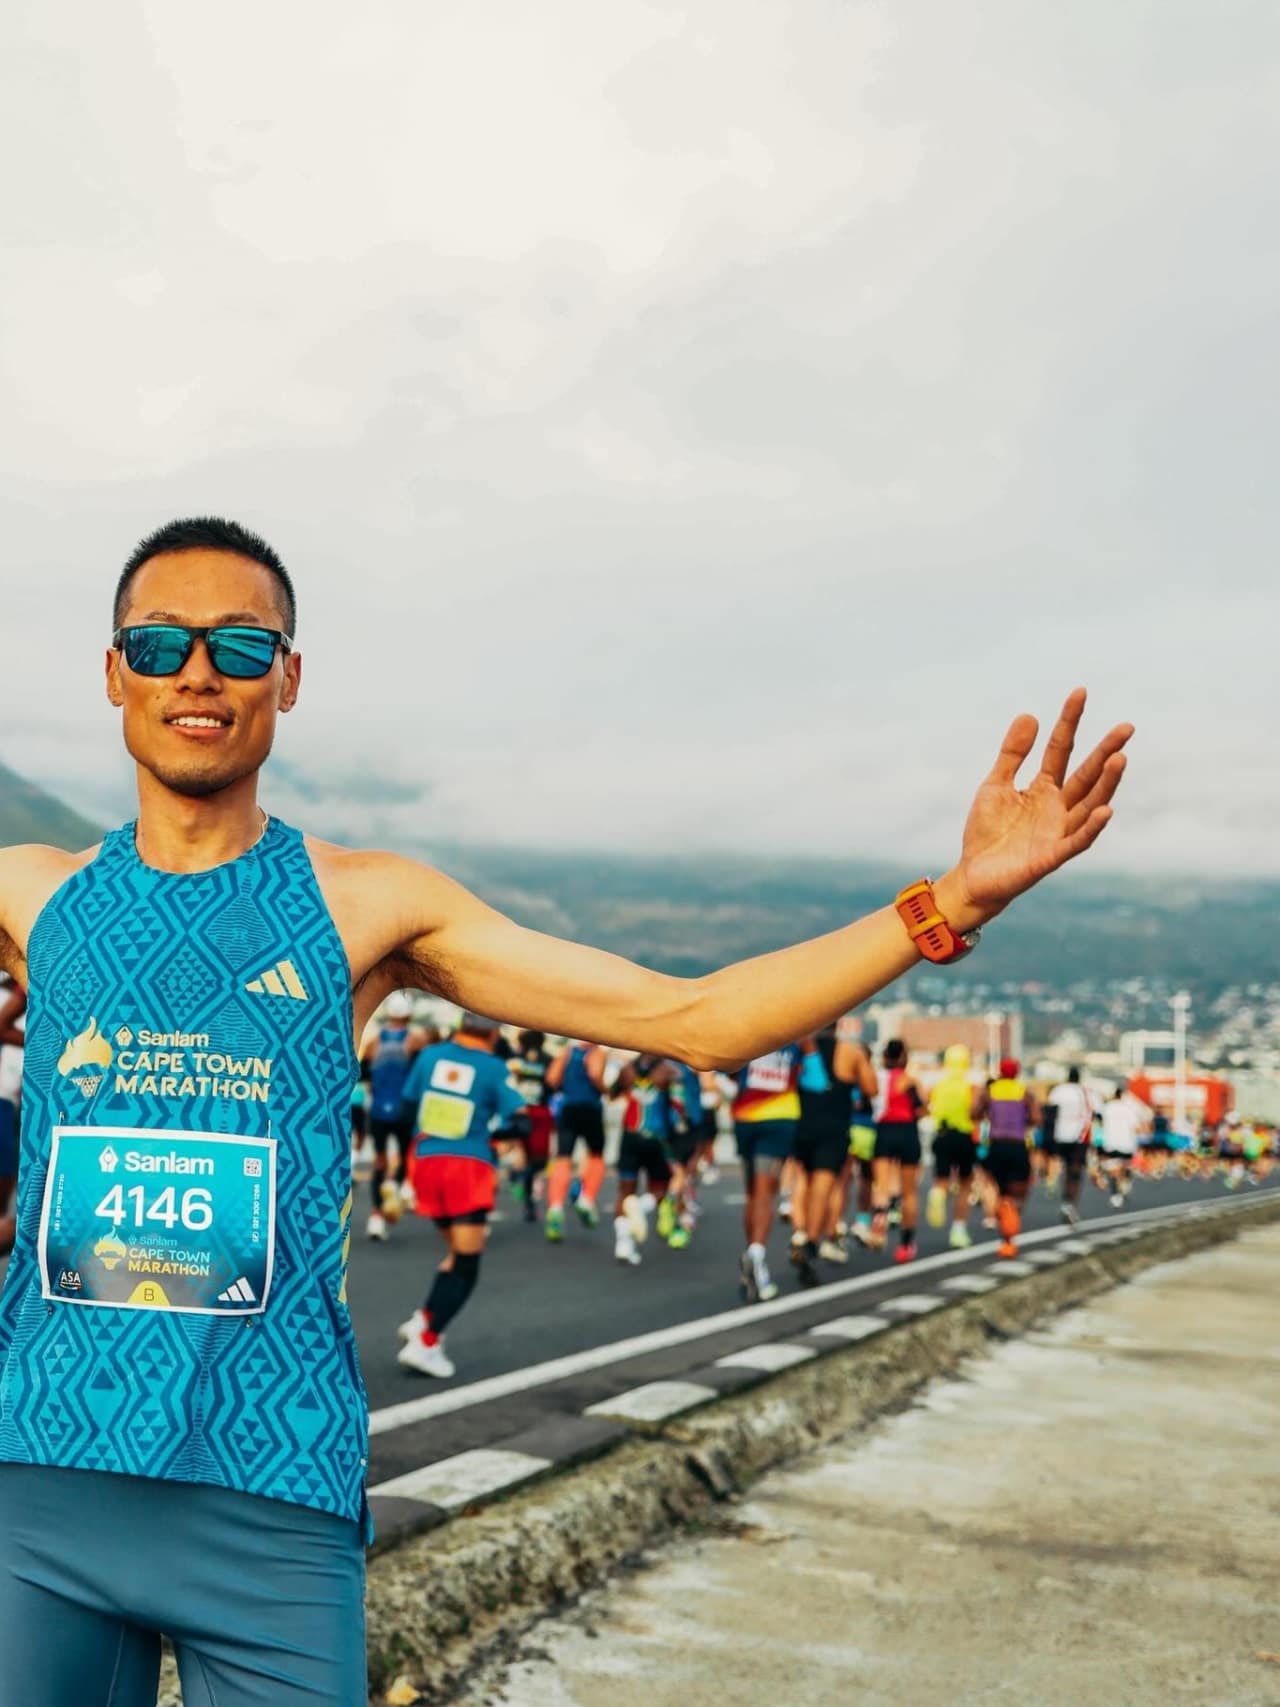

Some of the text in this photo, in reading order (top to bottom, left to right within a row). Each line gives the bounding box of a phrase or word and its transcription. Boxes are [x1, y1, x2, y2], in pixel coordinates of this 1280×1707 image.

[137, 1029, 209, 1048] Sanlam
[117, 1051, 273, 1078] CAPE TOWN
[115, 1073, 271, 1103] MARATHON
[124, 1150, 215, 1176] Sanlam
[94, 1183, 214, 1231] 4146
[140, 1235, 178, 1247] Sanlam
[128, 1247, 211, 1263] CAPE TOWN
[128, 1260, 210, 1276] MARATHON
[60, 1271, 81, 1283] ASA
[143, 1287, 155, 1302] B
